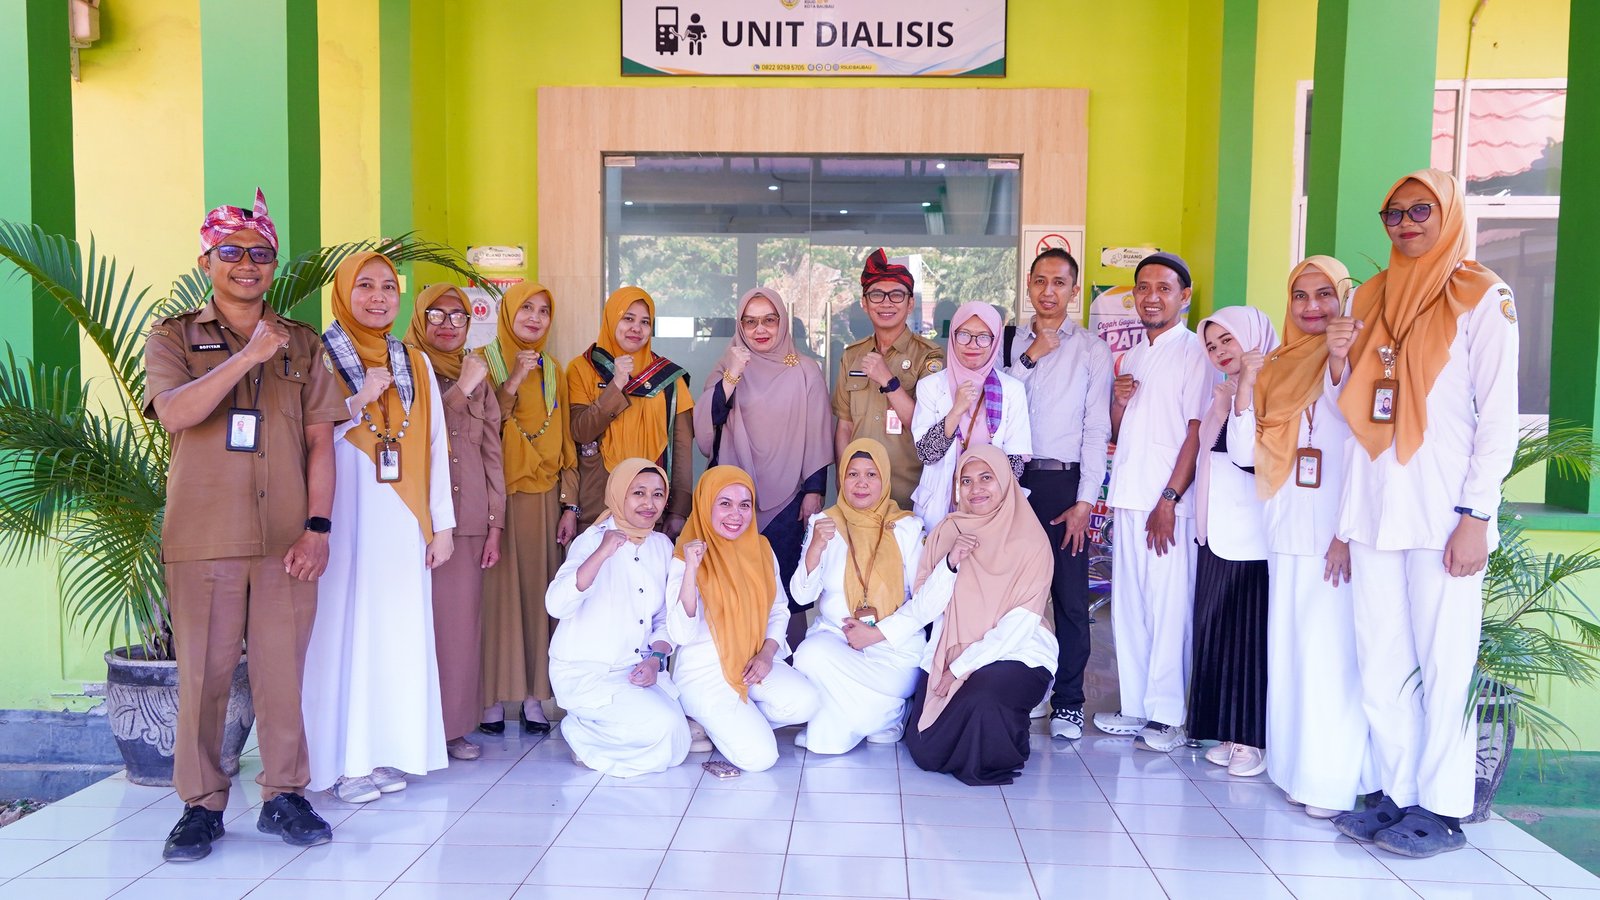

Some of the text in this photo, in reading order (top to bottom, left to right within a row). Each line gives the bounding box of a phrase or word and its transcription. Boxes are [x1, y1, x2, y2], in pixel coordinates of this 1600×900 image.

[722, 21, 954, 47] UNIT DIALISIS
[1097, 320, 1118, 331] Cegah
[1118, 319, 1136, 328] Gagal
[1106, 329, 1146, 350] PAT
